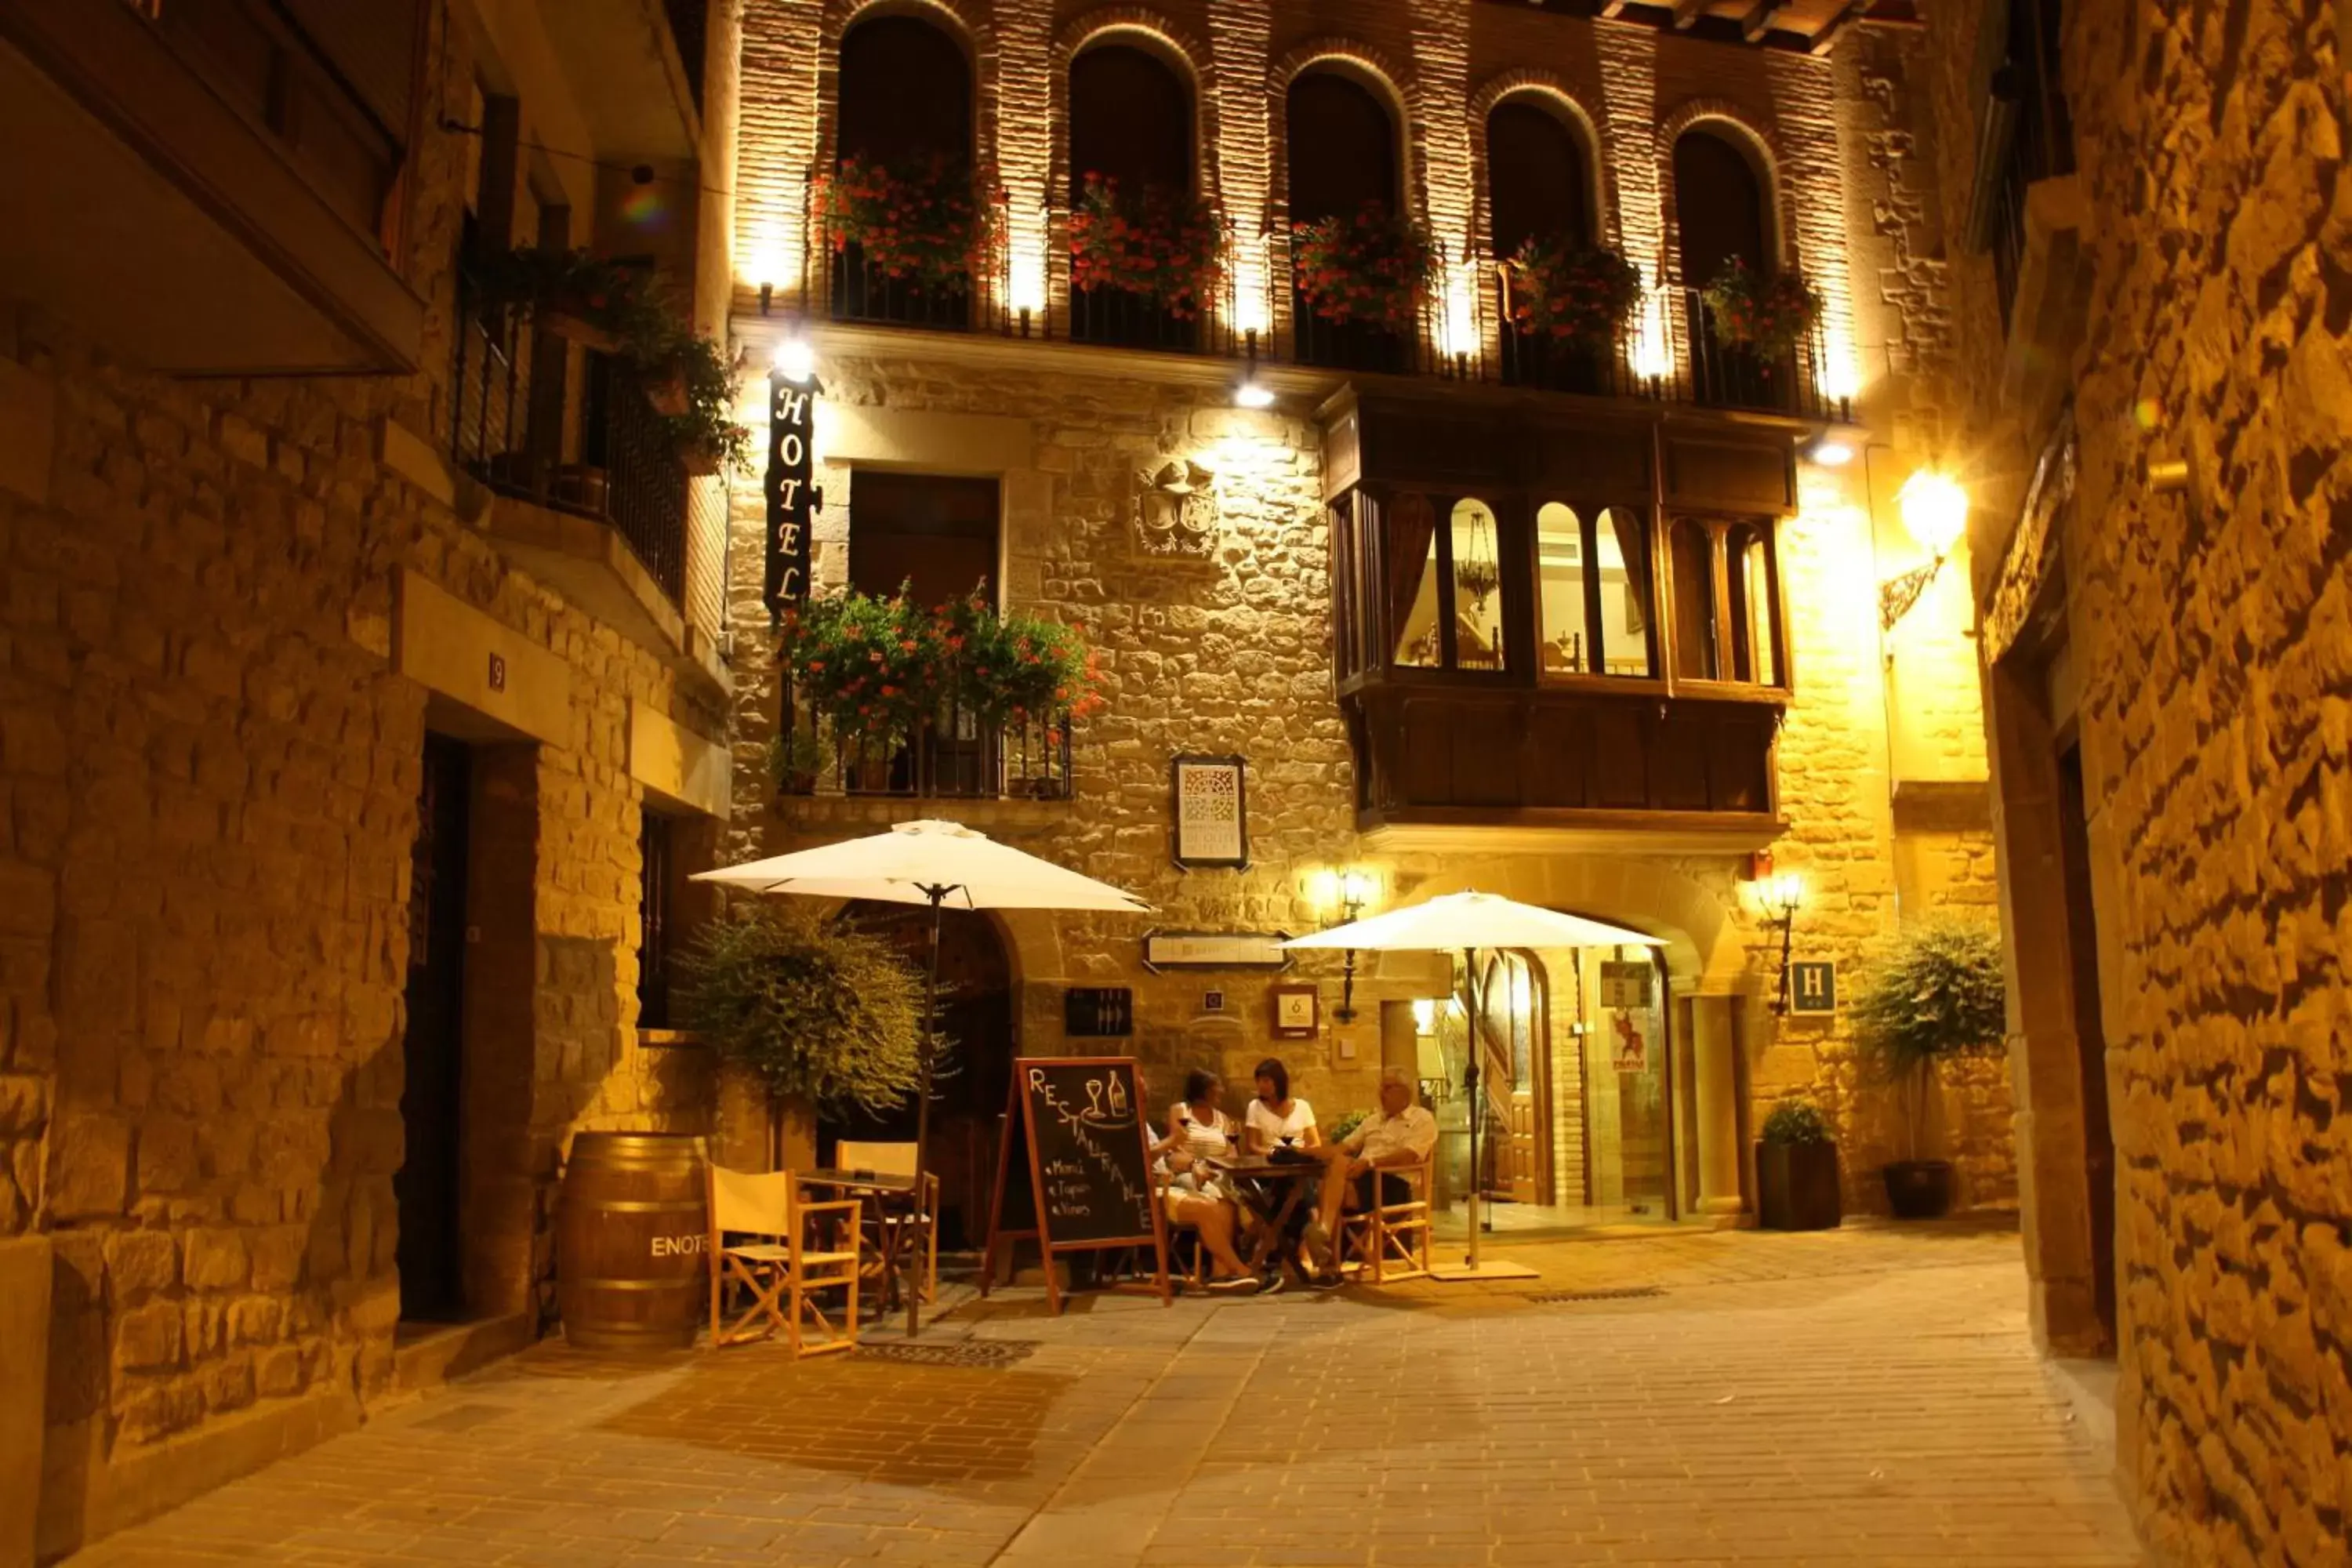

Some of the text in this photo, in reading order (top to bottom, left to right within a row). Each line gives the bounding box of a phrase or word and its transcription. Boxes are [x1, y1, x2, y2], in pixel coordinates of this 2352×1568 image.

[775, 387, 808, 602] HOTEL
[495, 661, 503, 685] 9
[1802, 967, 1824, 996] H
[1029, 1069, 1153, 1229] RESTAURANTE
